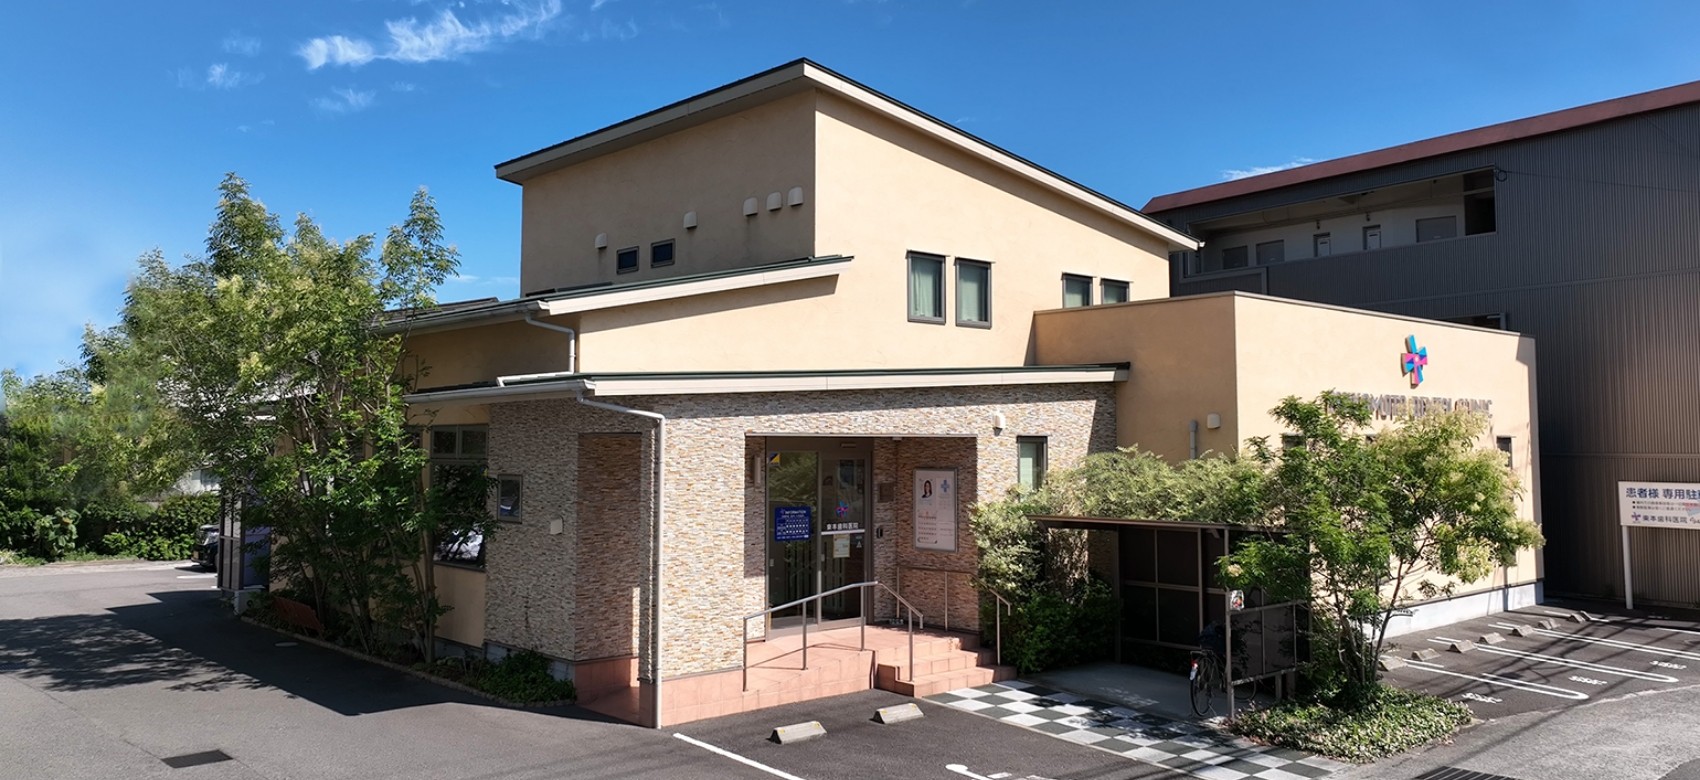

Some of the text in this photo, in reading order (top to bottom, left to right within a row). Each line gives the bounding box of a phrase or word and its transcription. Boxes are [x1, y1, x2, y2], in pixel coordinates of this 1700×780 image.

[1626, 488, 1700, 500] 患者様 専用駐
